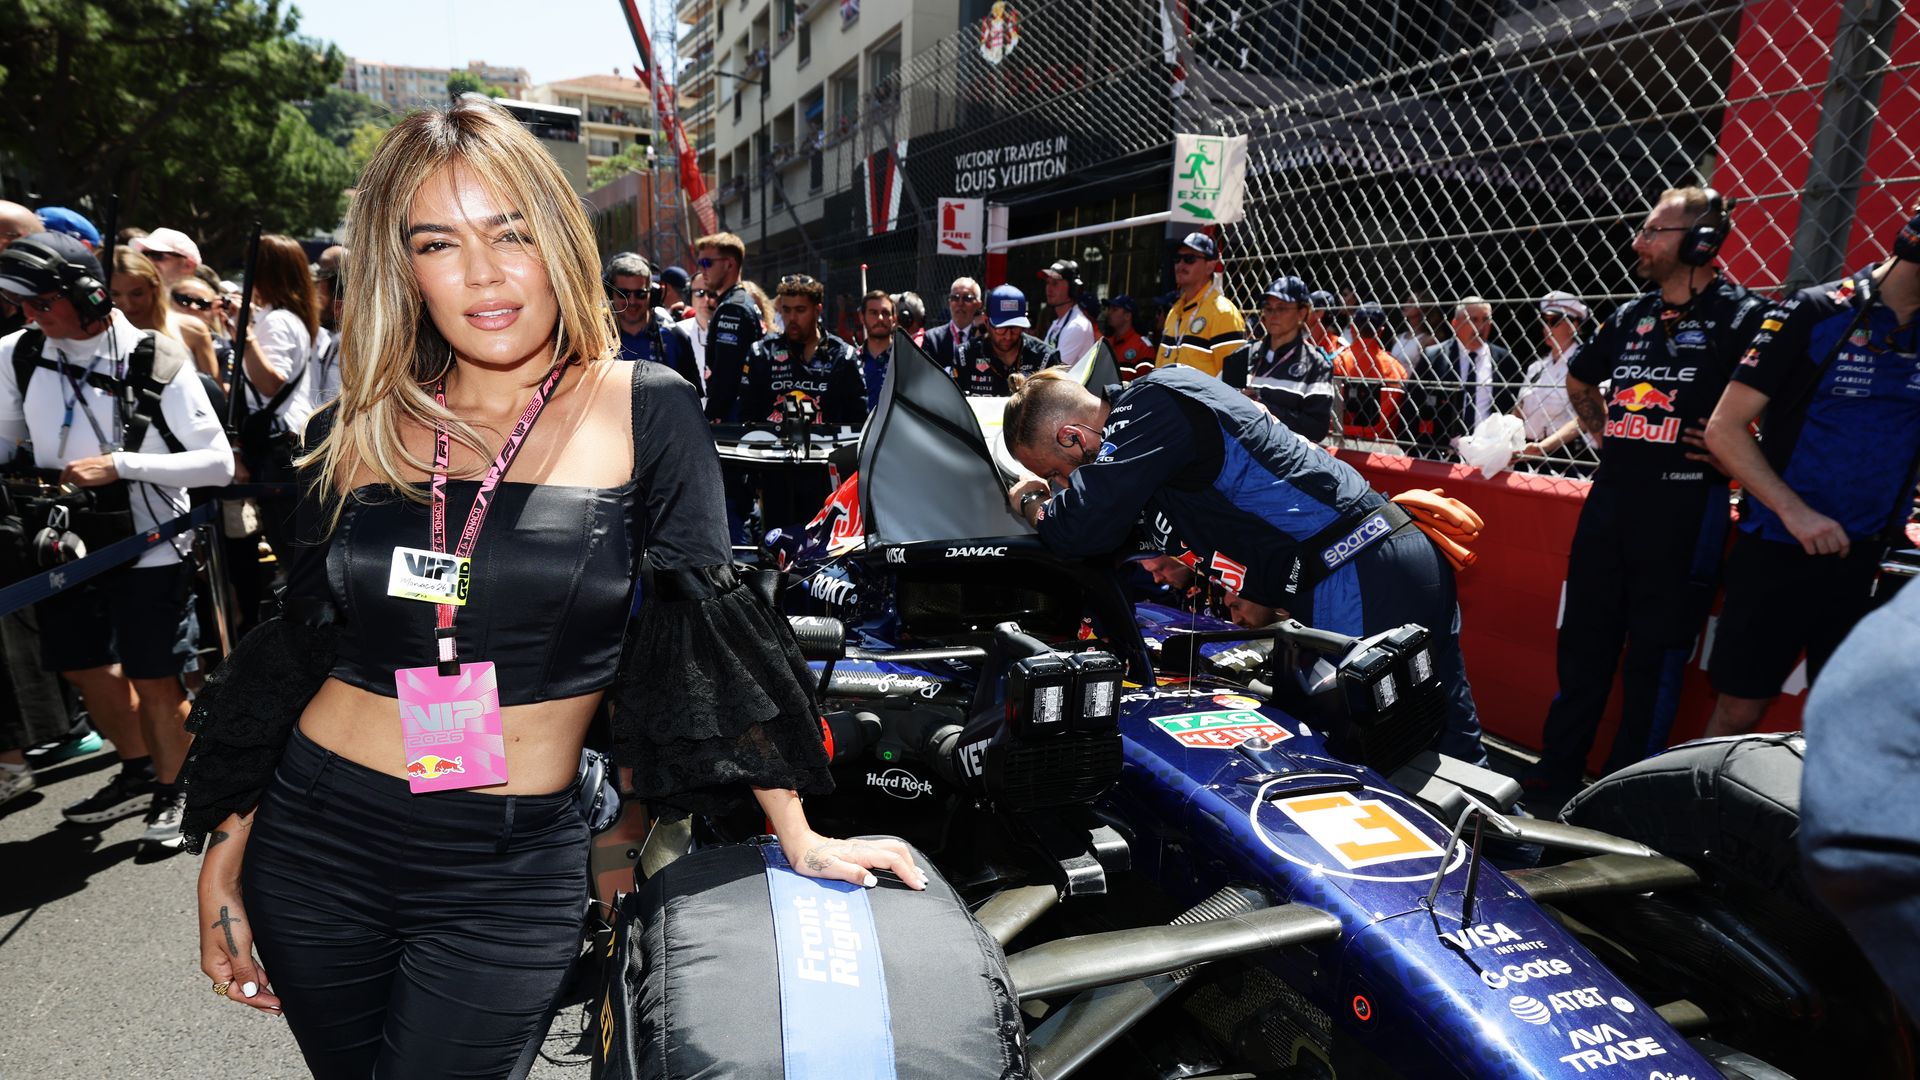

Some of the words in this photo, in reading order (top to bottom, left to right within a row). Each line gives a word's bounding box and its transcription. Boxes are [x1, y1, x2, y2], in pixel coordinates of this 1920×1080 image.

[955, 148, 1000, 170] VICTORY
[1004, 139, 1052, 162] TRAVELS
[1055, 136, 1068, 151] IN
[955, 168, 996, 193] LOUIS
[1001, 156, 1067, 186] VUITTON
[1177, 190, 1220, 200] EXIT
[771, 381, 828, 391] ORACLE
[1613, 366, 1697, 381] ORACLE
[523, 399, 541, 423] 2026
[512, 422, 526, 437] VIP
[435, 502, 443, 534] MONACO
[463, 508, 482, 540] MONACO
[1323, 516, 1387, 563] sparco
[403, 552, 457, 580] VIP
[886, 548, 906, 564] VISA
[945, 547, 1007, 558] DAMAC
[457, 562, 470, 600] GRID
[811, 574, 856, 605] ROKT
[408, 700, 484, 731] VIP
[1164, 712, 1261, 728] TAG
[407, 730, 464, 748] 2026
[1179, 726, 1284, 746] HEUER
[866, 772, 899, 788] Hard
[901, 776, 933, 795] Rock
[792, 896, 828, 984] Front
[824, 899, 861, 988] Right
[1438, 923, 1523, 950] VISA
[1494, 940, 1548, 955] INFINITE
[1547, 987, 1608, 1014] AT&T
[1568, 1024, 1628, 1049] AVA
[1559, 1037, 1667, 1073] TRADE
